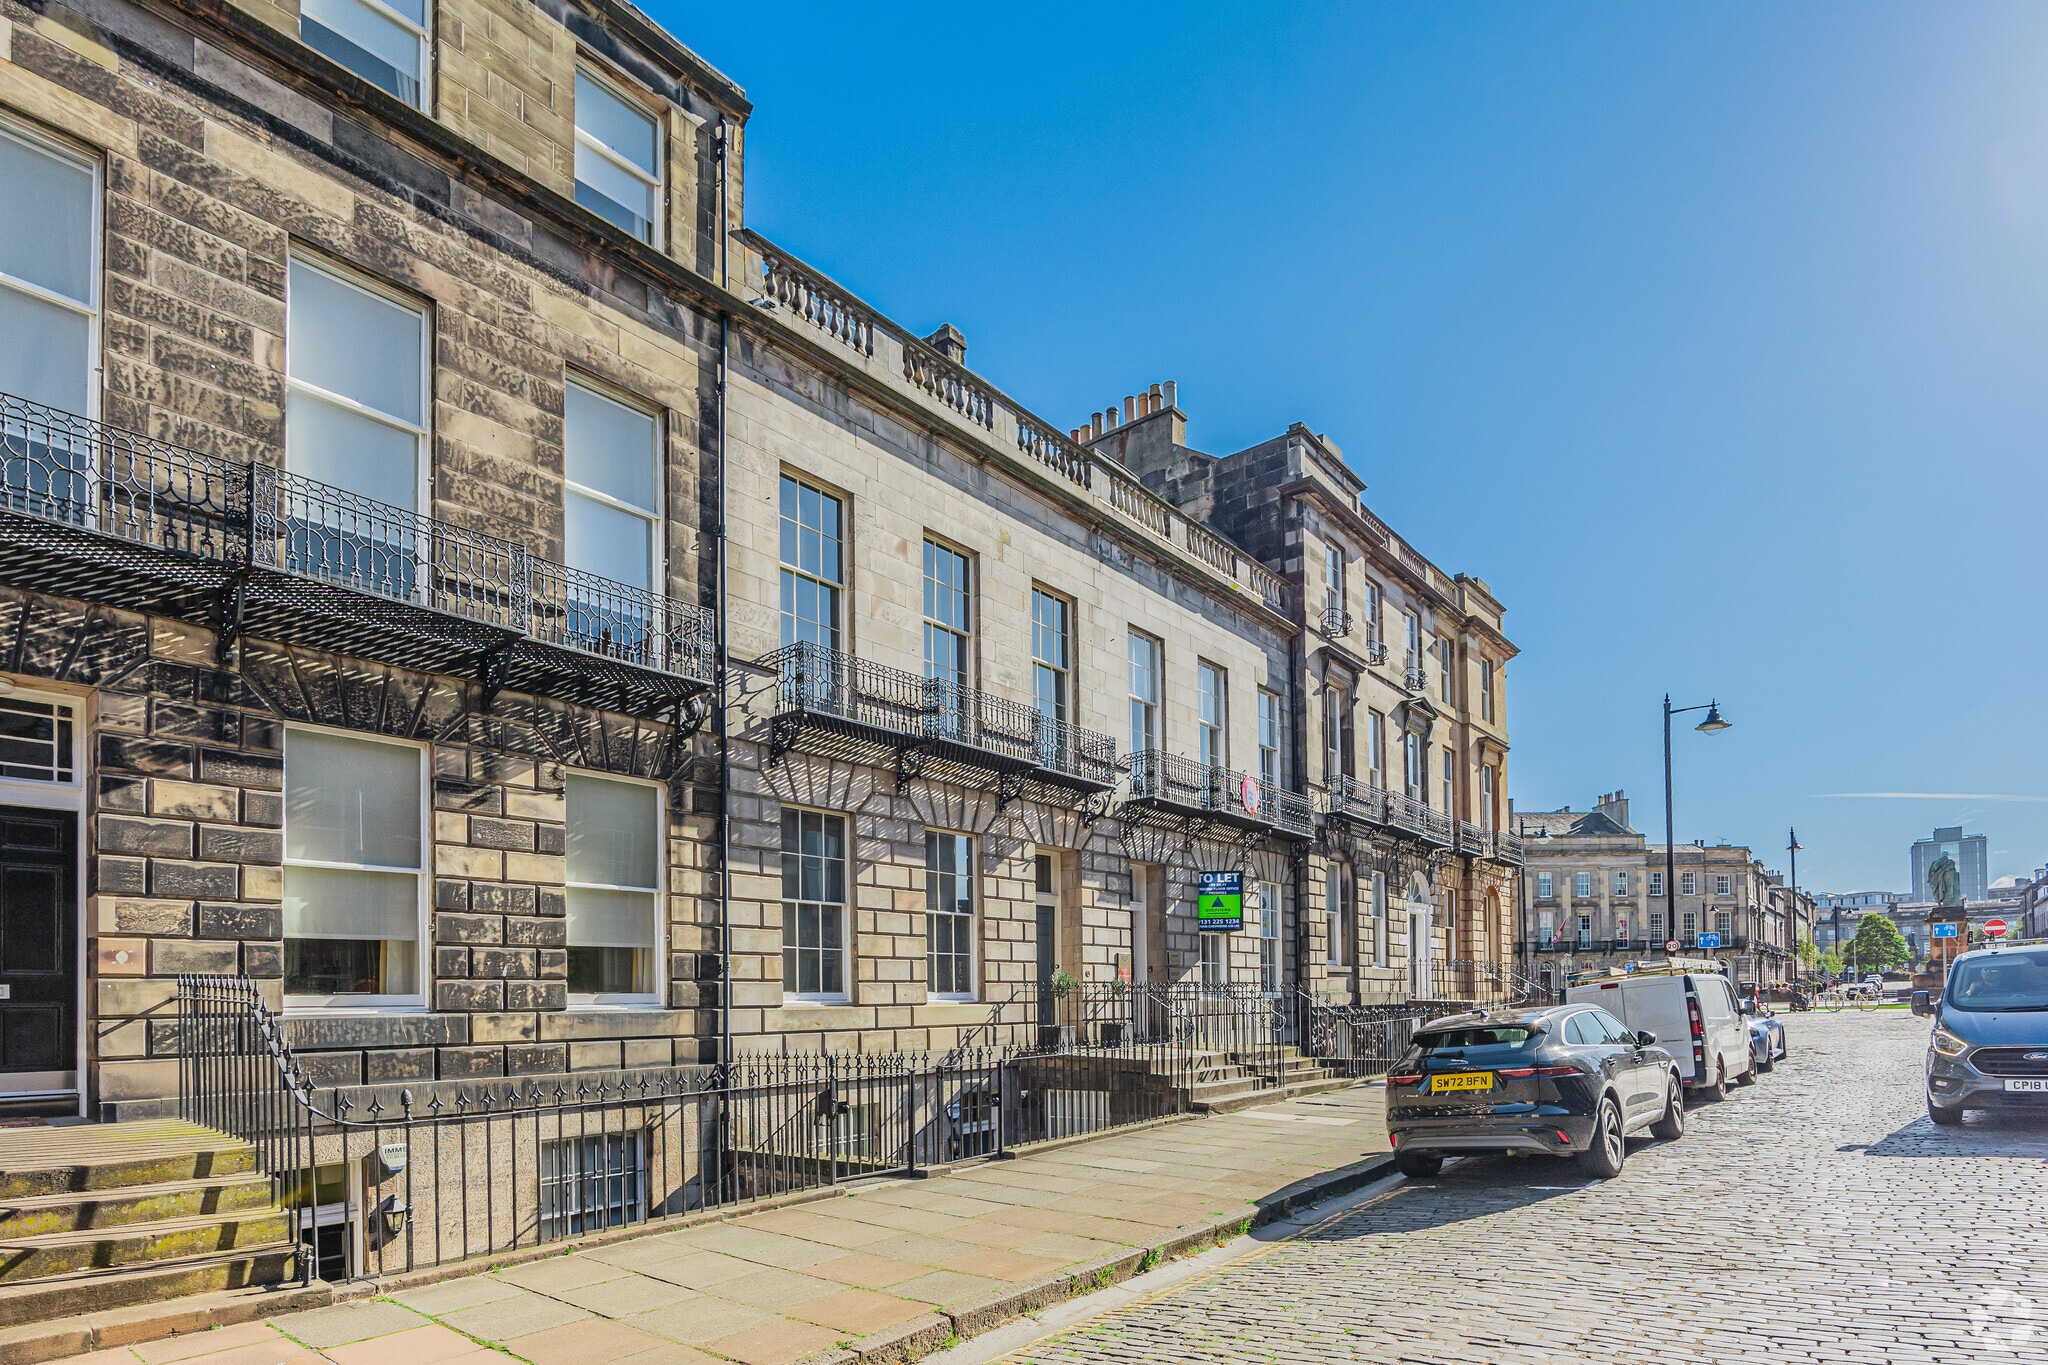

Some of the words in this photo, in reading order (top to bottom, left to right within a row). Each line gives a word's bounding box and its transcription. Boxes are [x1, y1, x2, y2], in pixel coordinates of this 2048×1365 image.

[1199, 873, 1213, 883] TO
[1217, 872, 1239, 883] LET
[1436, 1079, 1464, 1088] SW72
[1465, 1076, 1488, 1086] BFN
[2013, 1081, 2041, 1090] CP18
